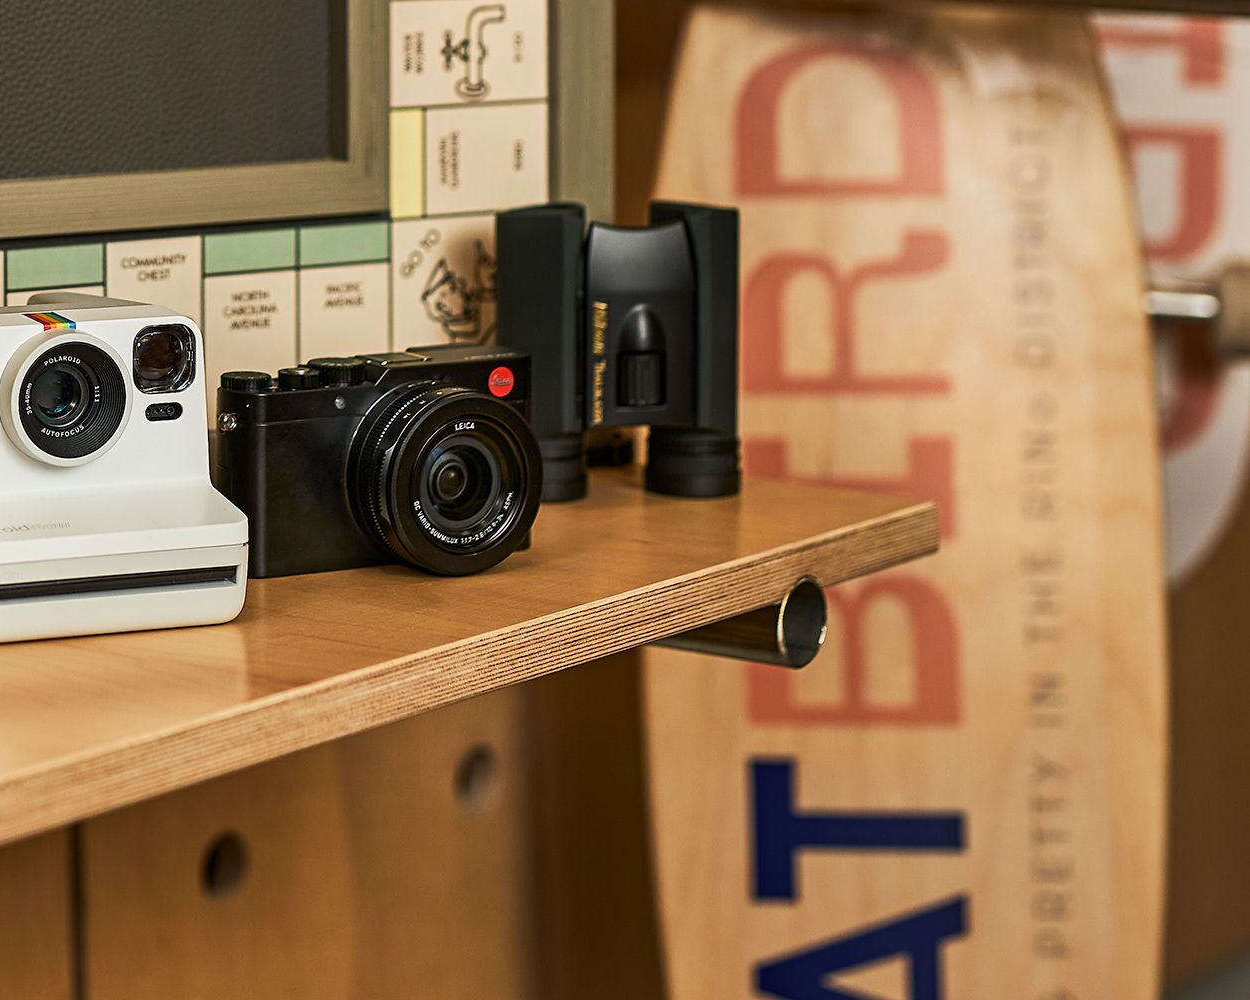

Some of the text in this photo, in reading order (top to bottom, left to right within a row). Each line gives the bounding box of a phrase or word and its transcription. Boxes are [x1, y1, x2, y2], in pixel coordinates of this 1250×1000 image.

[120, 253, 188, 269] COMMUNITY
[137, 269, 171, 282] CHEST
[44, 355, 81, 366] POLAROID
[40, 424, 85, 437] AUTOFOCUS
[454, 421, 475, 431] LEICA
[413, 500, 421, 511] DC
